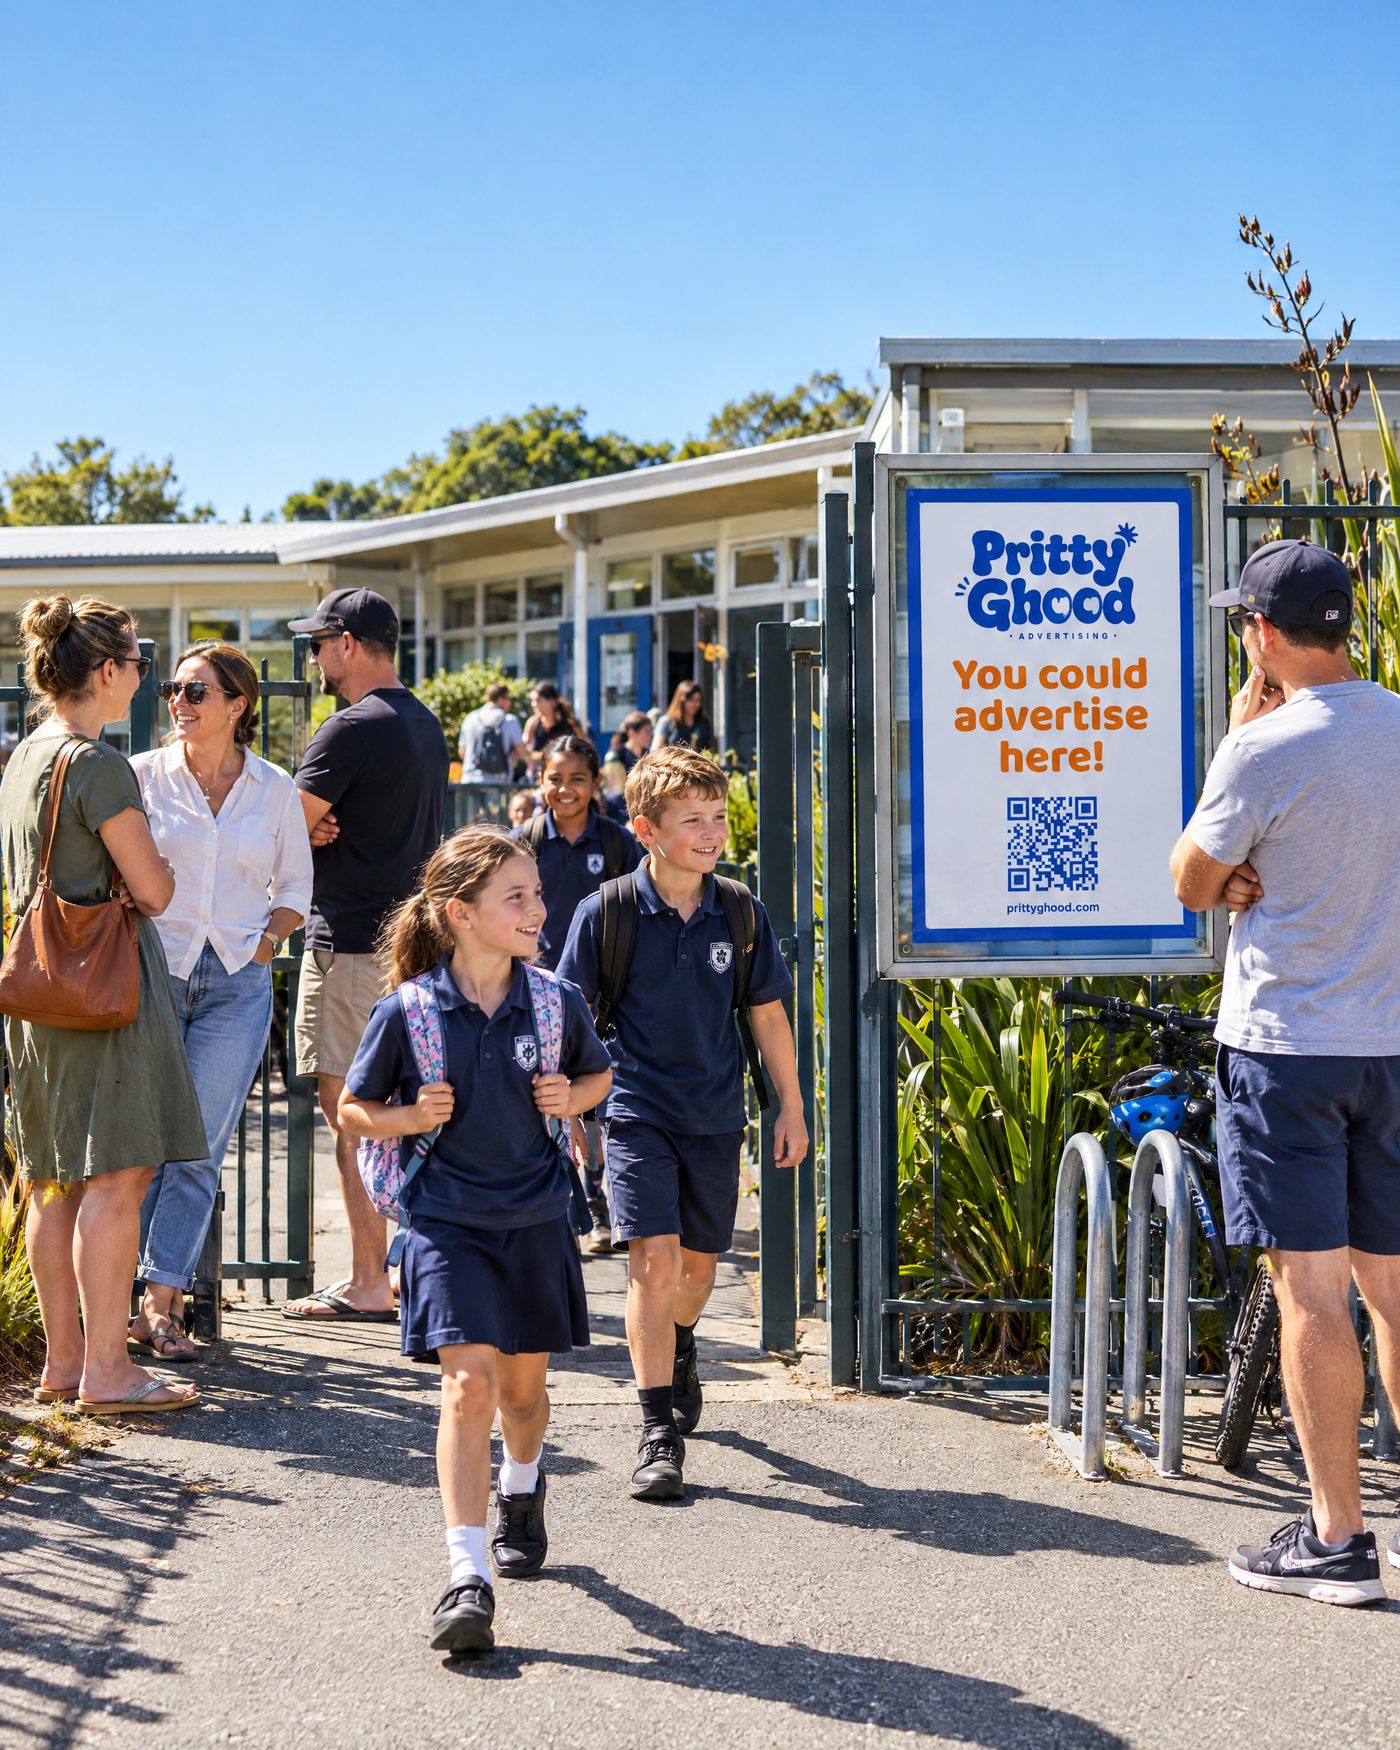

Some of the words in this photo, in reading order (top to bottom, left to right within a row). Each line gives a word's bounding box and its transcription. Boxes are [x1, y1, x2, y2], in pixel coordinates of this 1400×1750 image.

[972, 530, 1126, 587] Pritty
[967, 576, 1136, 632] Ghood
[1018, 632, 1109, 641] ADVERTISING
[953, 659, 1026, 690] You
[1038, 658, 1148, 690] could
[954, 696, 1149, 732] advertise
[1000, 740, 1104, 773] here!
[1006, 902, 1100, 915] prittyghood.com
